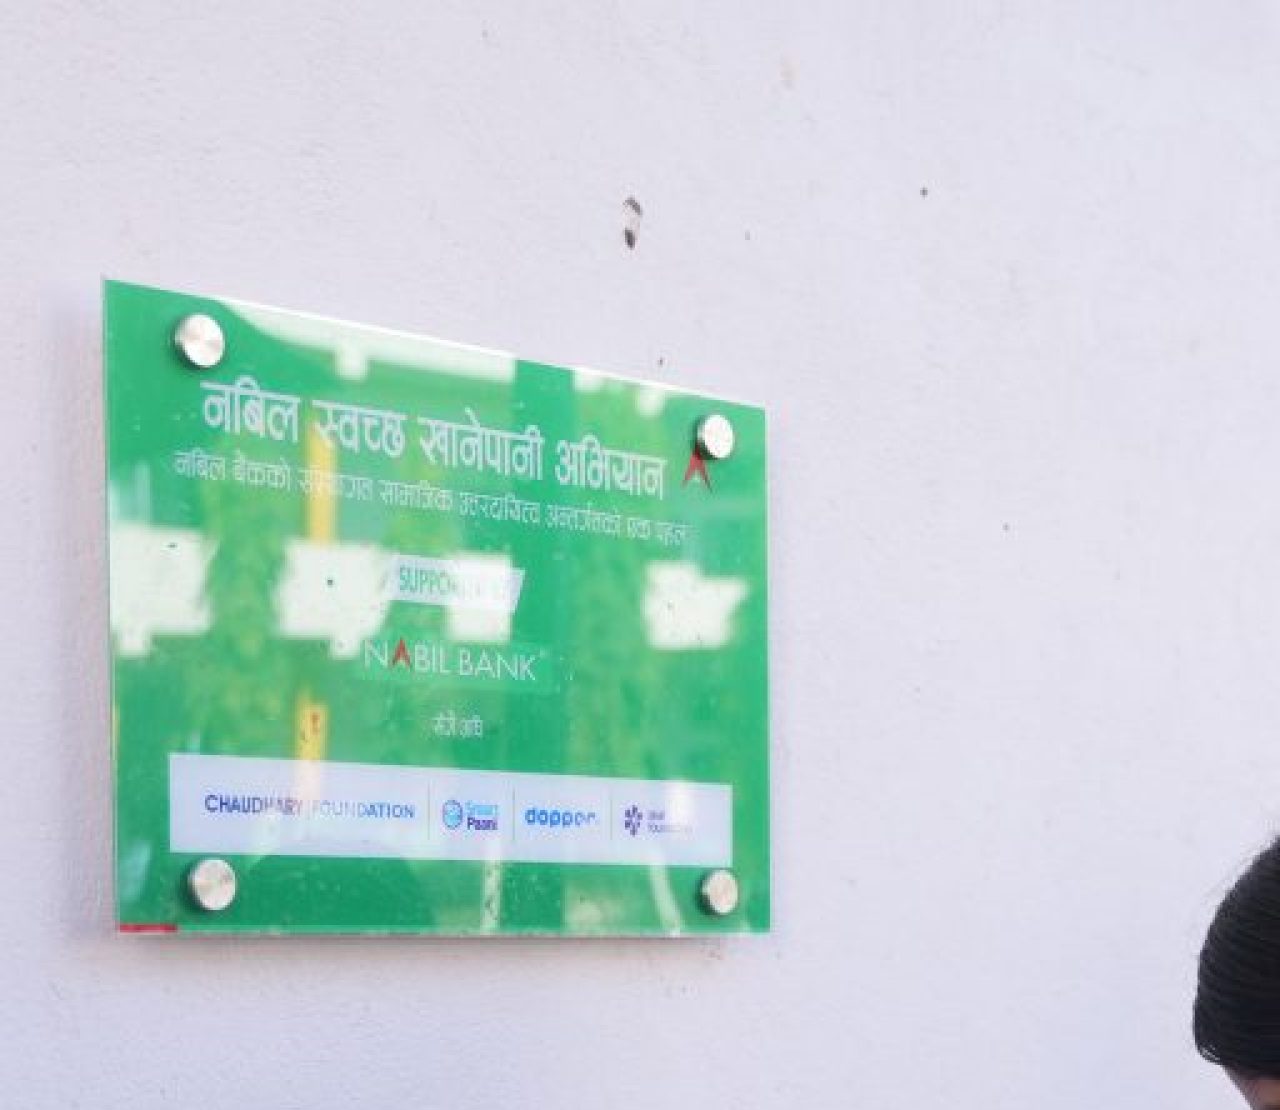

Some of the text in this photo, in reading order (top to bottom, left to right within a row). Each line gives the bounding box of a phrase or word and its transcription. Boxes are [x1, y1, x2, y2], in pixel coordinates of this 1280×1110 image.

[200, 376, 667, 500] नबिल स्वच्छ खानेपानी अभियान
[174, 447, 226, 480] नबिल
[364, 637, 537, 681] NABIL BANK
